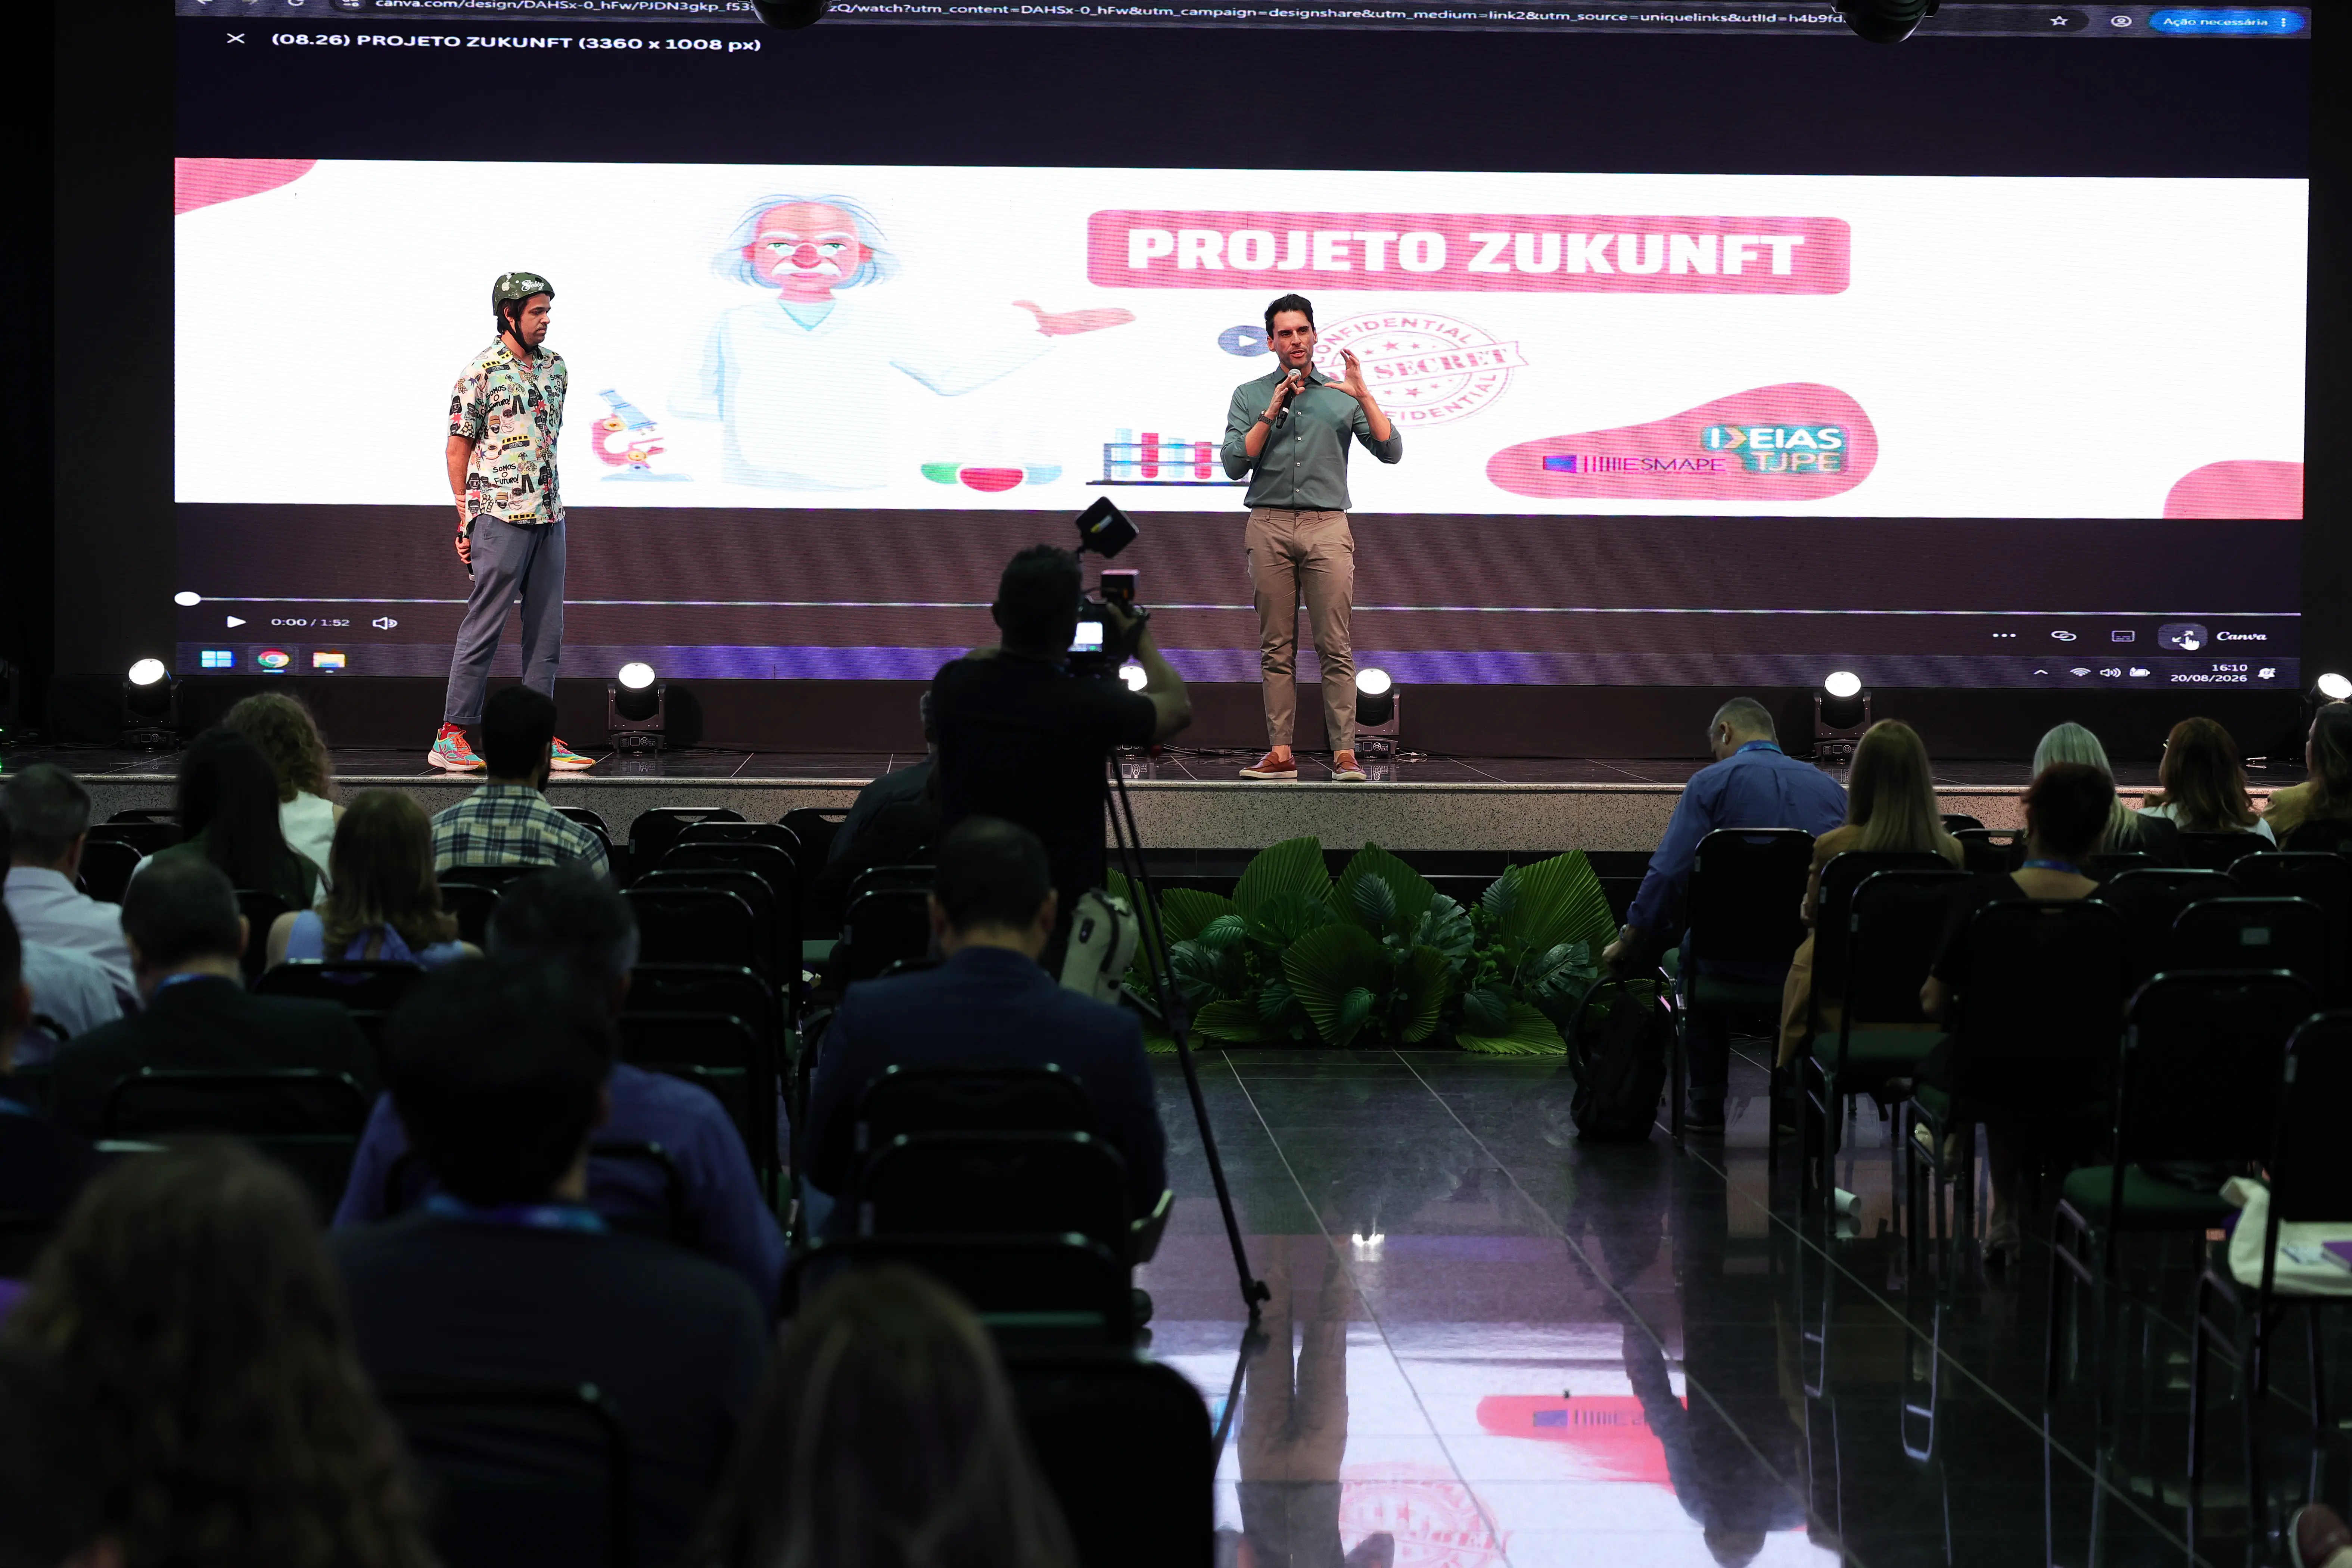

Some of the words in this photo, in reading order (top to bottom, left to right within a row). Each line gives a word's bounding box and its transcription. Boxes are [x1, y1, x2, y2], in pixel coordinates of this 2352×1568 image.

[2164, 17, 2196, 27] Ação
[2200, 18, 2268, 26] necessária
[272, 34, 350, 46] (08.26)
[357, 35, 461, 47] PROJETO
[467, 37, 573, 49] ZUKUNFT
[579, 37, 643, 50] (3360
[648, 40, 660, 49] x
[666, 39, 722, 50] 1008
[728, 39, 761, 52] px)
[1128, 228, 1447, 272] PROJETO
[1468, 232, 1805, 275] ZUKUNFT
[1374, 349, 1507, 379] SECRET
[486, 385, 506, 400] SOMOS
[1383, 375, 1497, 420] FIDENTIAL
[492, 463, 516, 473] SOMOS
[1624, 458, 1726, 471] ESMAPE
[1751, 451, 1841, 472] TJPE
[494, 474, 519, 485] FUTURO!
[2216, 631, 2268, 641] Canva
[2171, 674, 2247, 682] 20/08/2026
